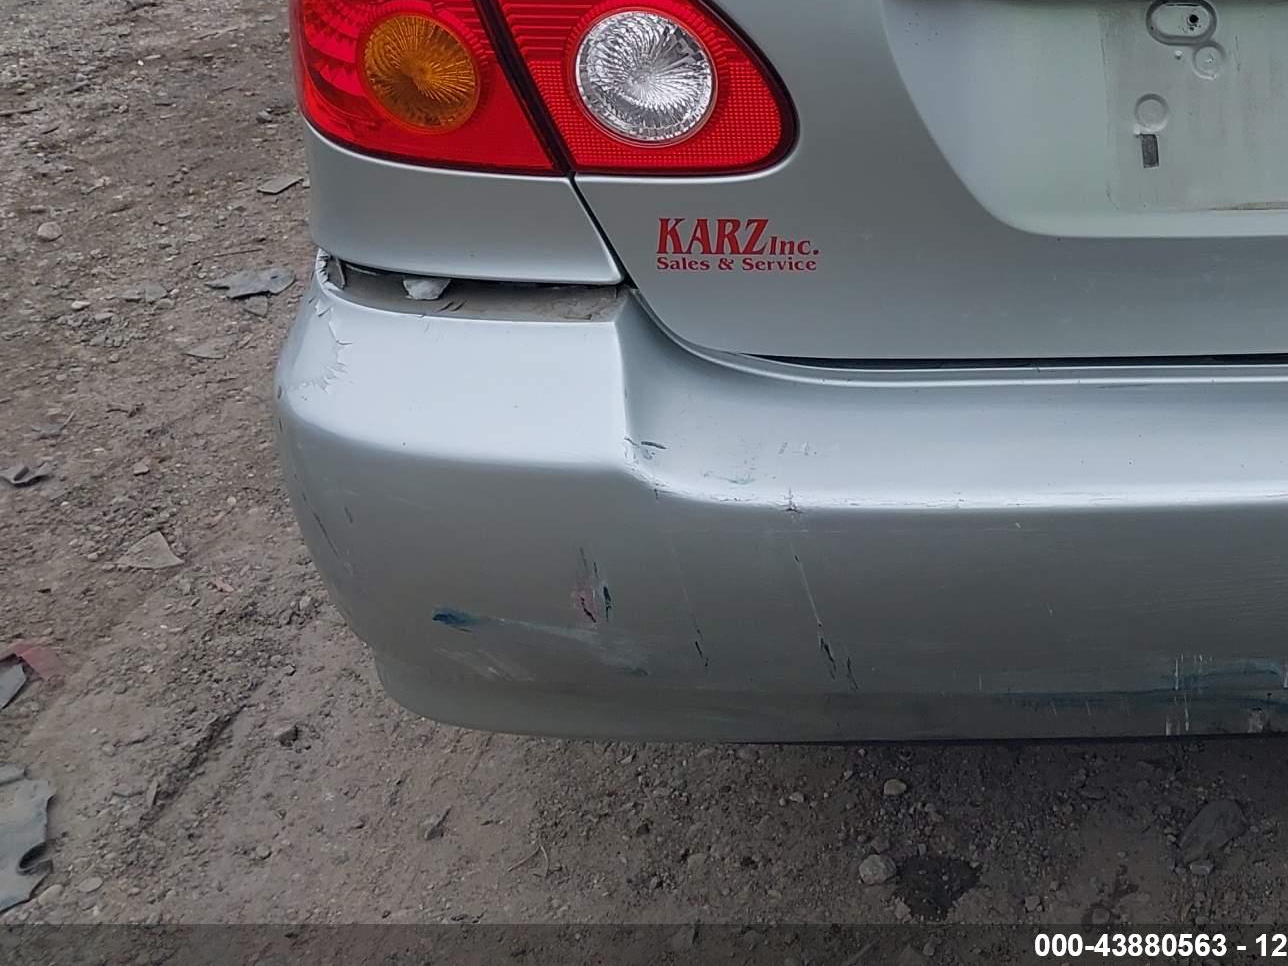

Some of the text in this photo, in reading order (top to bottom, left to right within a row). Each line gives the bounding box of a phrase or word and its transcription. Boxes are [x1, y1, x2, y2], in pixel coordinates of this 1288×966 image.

[656, 218, 819, 255] KARZ Inc.
[657, 257, 817, 271] Sales & Service
